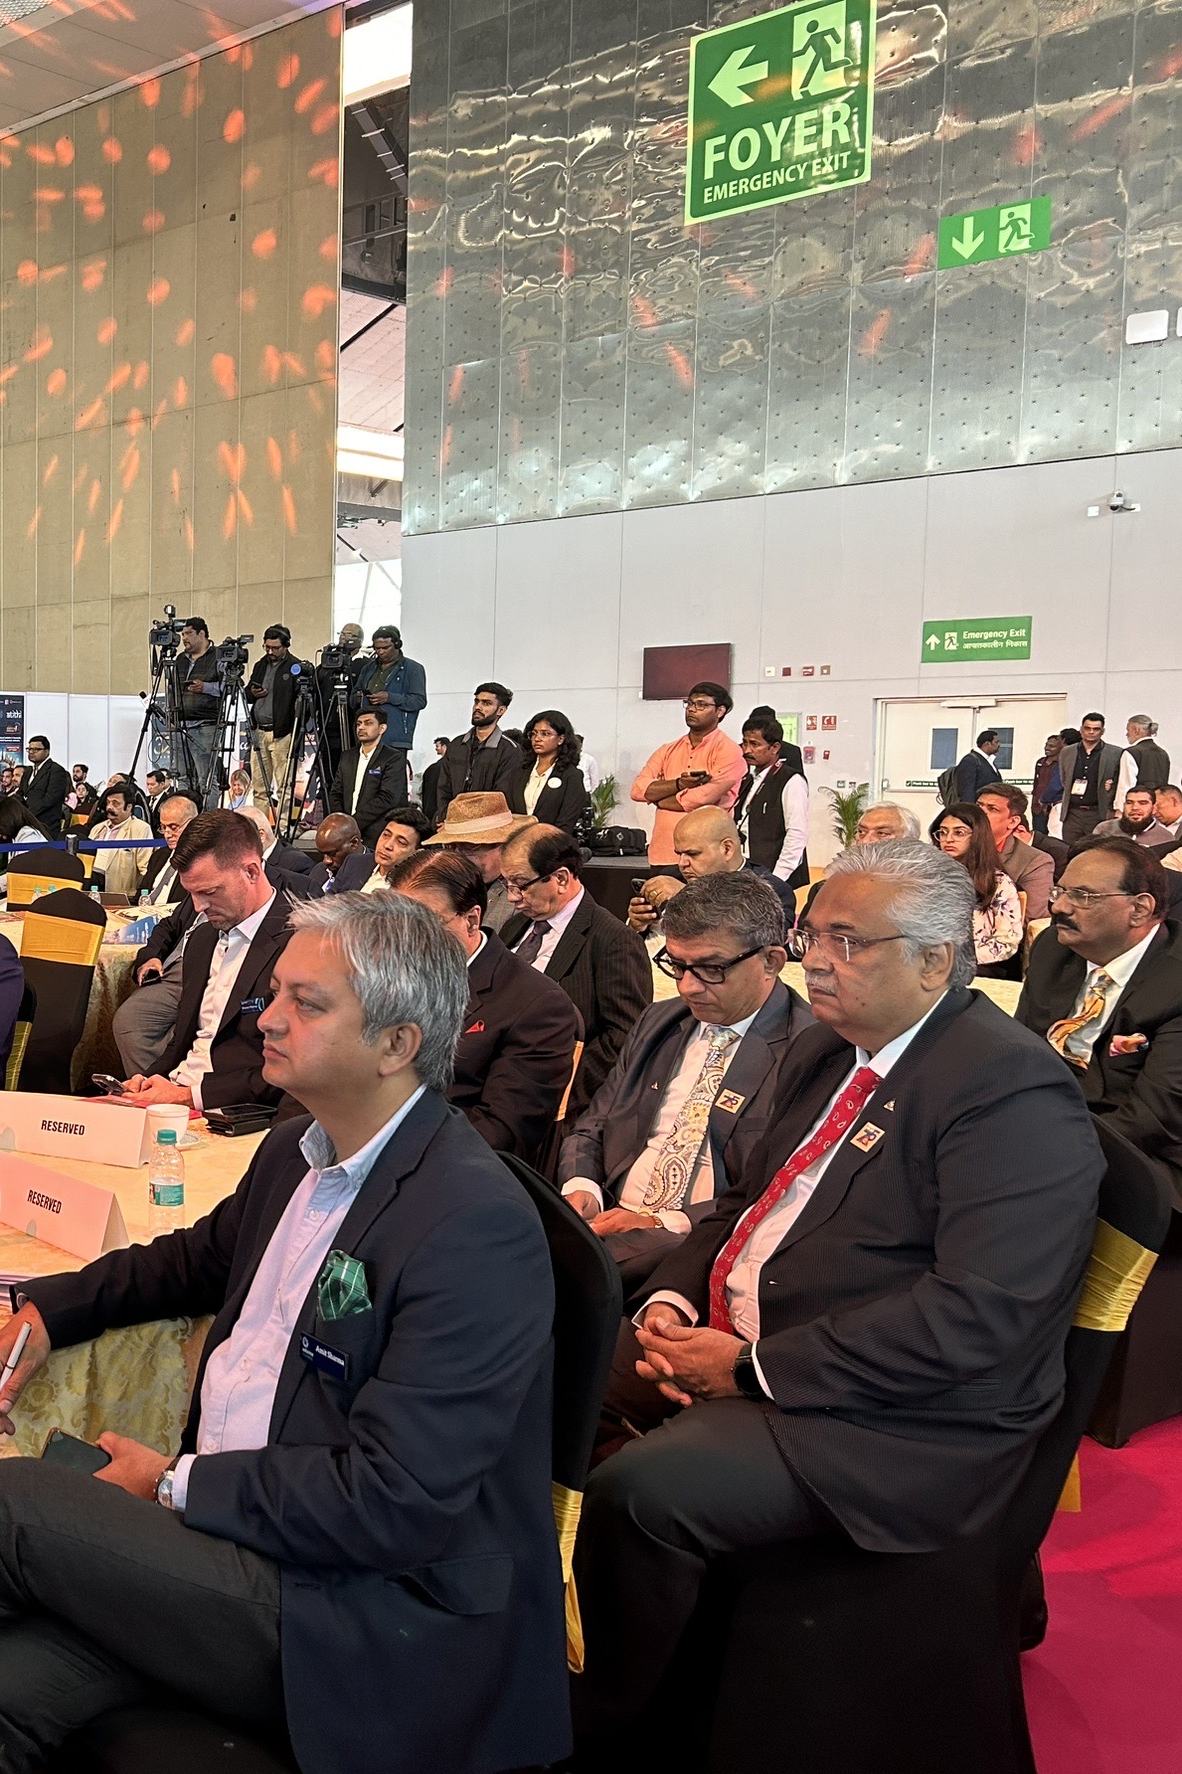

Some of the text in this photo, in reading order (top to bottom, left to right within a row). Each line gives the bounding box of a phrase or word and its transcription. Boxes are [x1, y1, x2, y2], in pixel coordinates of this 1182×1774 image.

[703, 102, 851, 181] FOYER
[703, 151, 852, 204] EMERGENCY EXIT
[962, 628, 1026, 640] Emergency Exit
[41, 1120, 85, 1136] RESERVED
[27, 1189, 62, 1214] RESERVED
